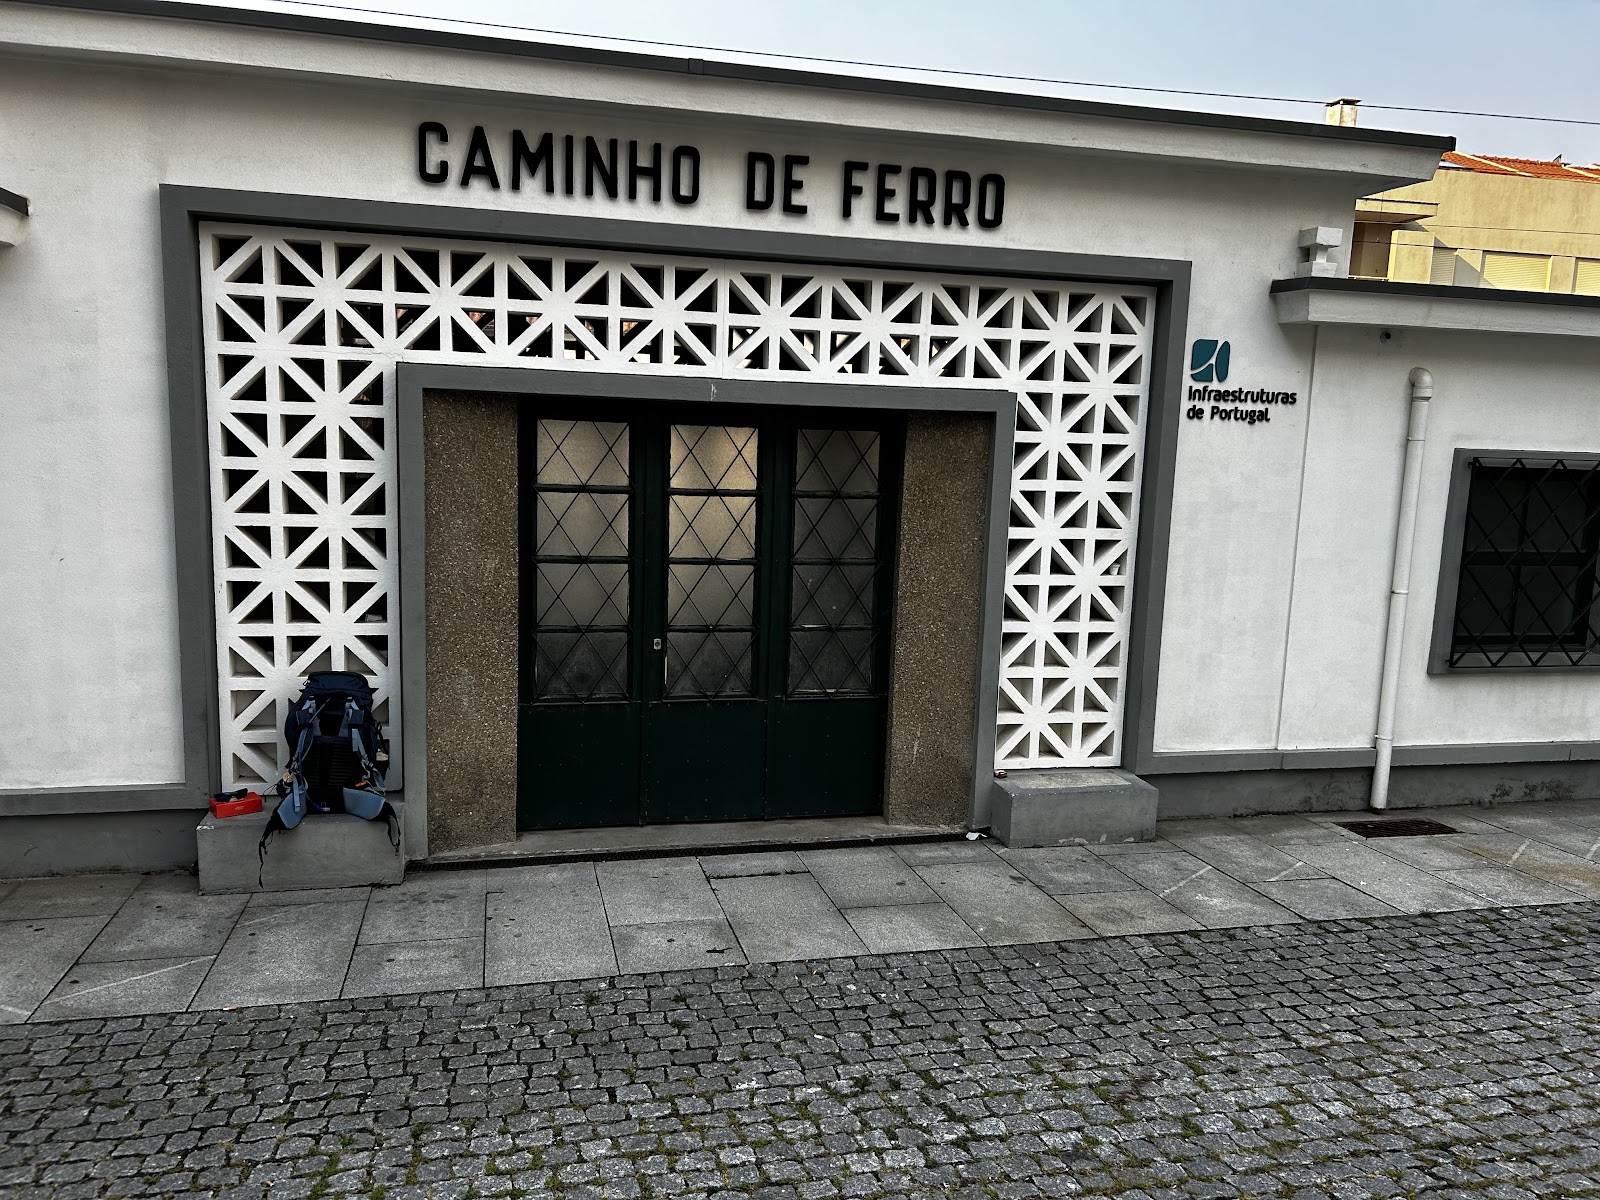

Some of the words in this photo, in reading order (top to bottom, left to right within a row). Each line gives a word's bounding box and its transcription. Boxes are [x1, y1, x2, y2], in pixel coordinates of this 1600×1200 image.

[417, 121, 701, 205] CAMINHO
[745, 151, 810, 215] DE
[842, 160, 1006, 229] FERRO
[1188, 385, 1297, 405] Infraestruturas
[1187, 405, 1205, 420] de
[1210, 405, 1270, 425] Portugal
